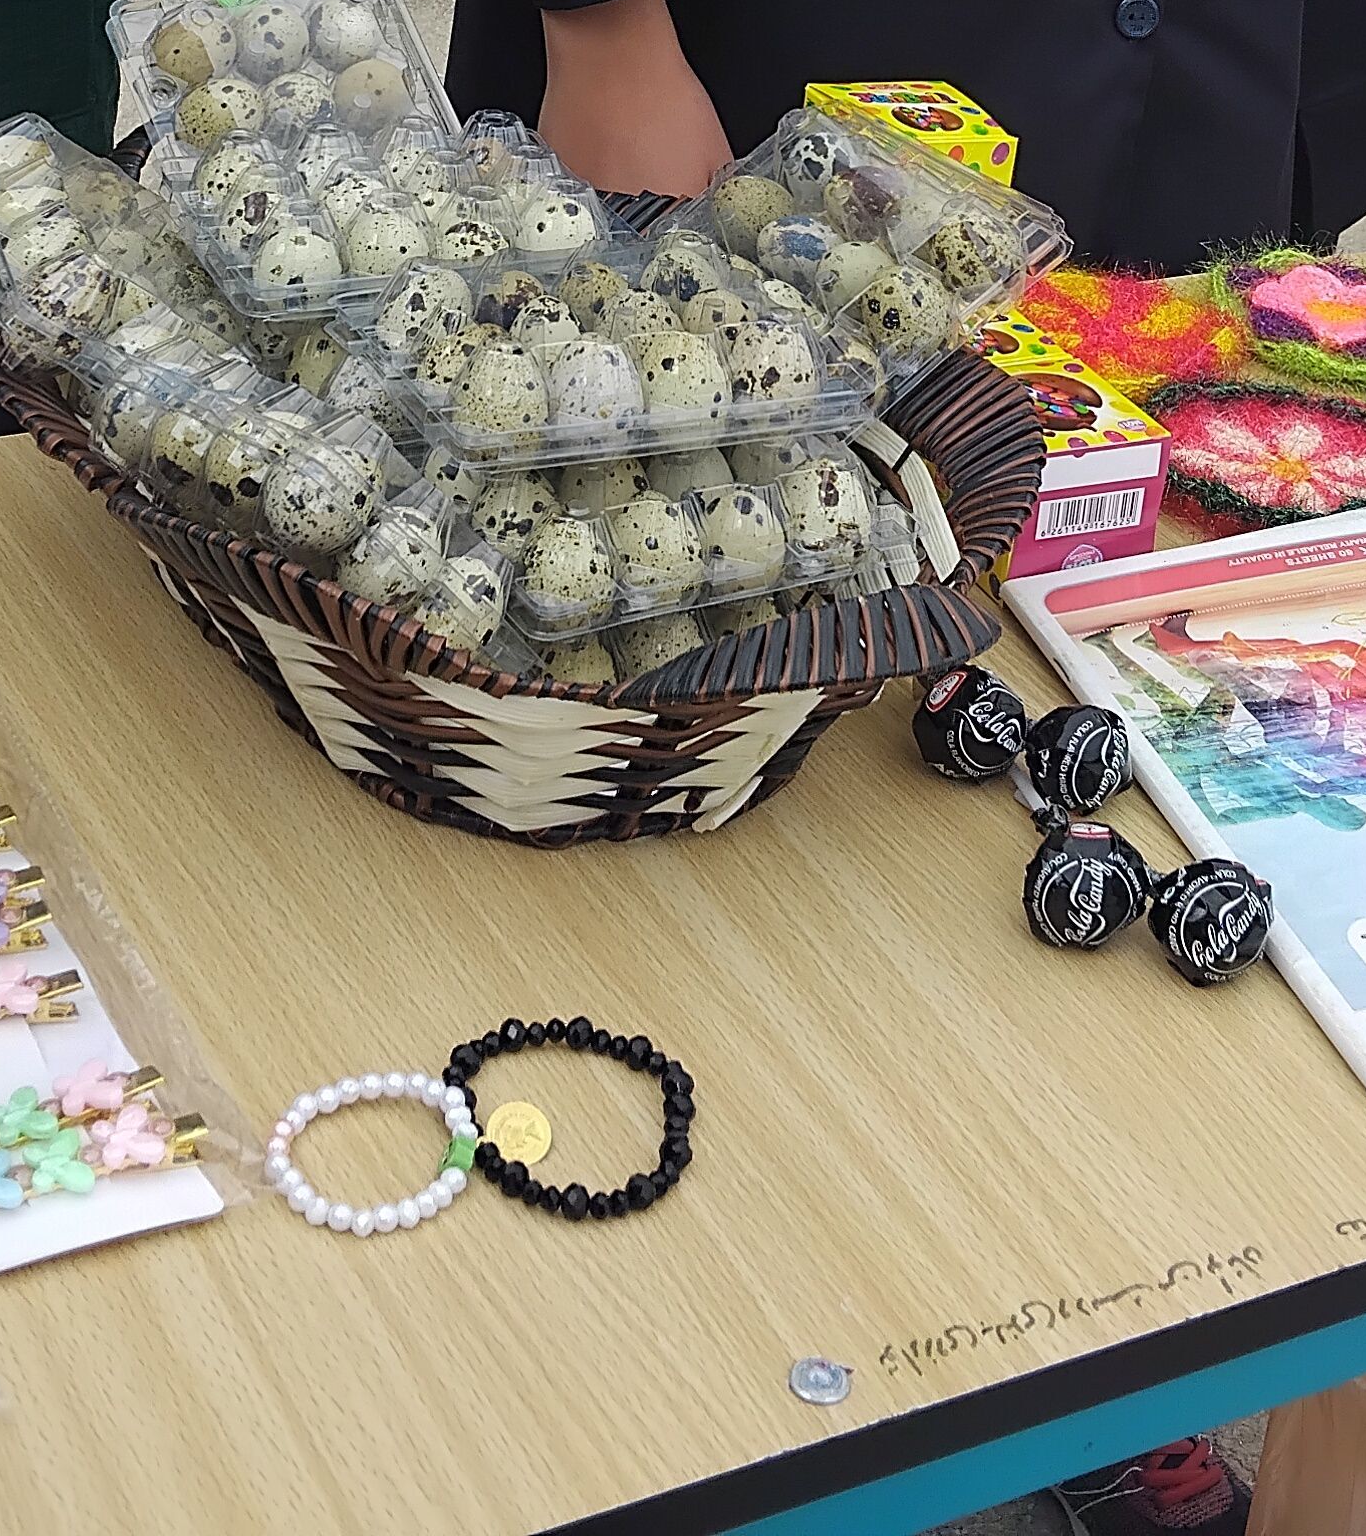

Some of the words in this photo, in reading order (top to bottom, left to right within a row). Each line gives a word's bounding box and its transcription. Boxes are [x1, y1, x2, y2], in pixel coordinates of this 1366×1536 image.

[1228, 552, 1272, 567] QUALITY
[1077, 858, 1112, 914] Candy
[1064, 909, 1093, 943] Cola
[1192, 923, 1229, 967] Cola
[1225, 891, 1263, 942] Candy
